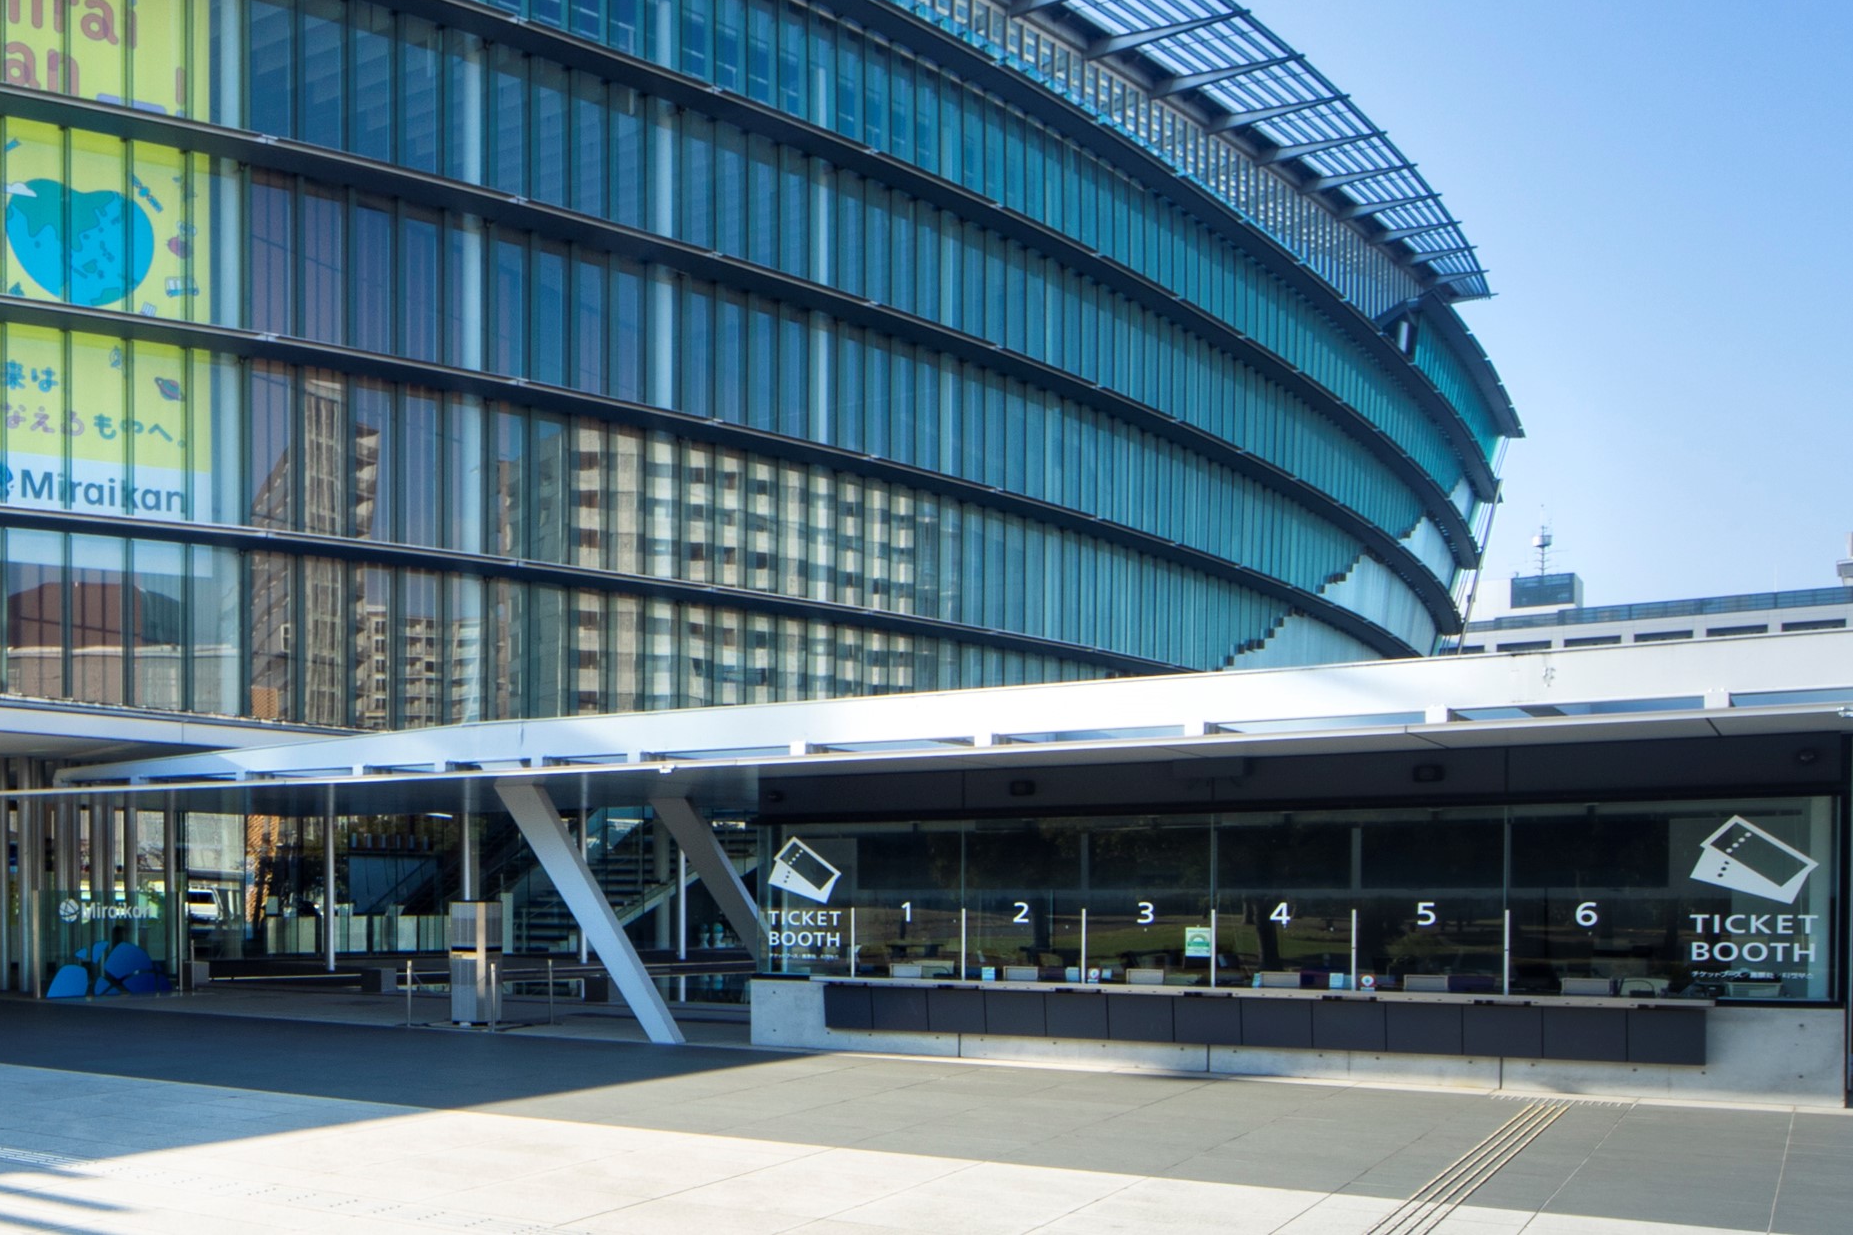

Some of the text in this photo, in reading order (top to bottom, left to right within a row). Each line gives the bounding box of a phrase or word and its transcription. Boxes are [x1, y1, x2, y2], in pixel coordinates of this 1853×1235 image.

[20, 468, 186, 514] Miraikan
[81, 902, 152, 919] Miraikan
[768, 911, 841, 926] TICKET
[901, 902, 911, 923] 1
[1013, 902, 1029, 923] 2
[1137, 902, 1155, 924] 3
[1269, 902, 1291, 925] 4
[1417, 902, 1436, 925] 5
[1576, 902, 1598, 926] 6
[1689, 914, 1819, 934] TICKET
[769, 931, 840, 947] BOOTH
[1691, 942, 1816, 963] BOOTH
